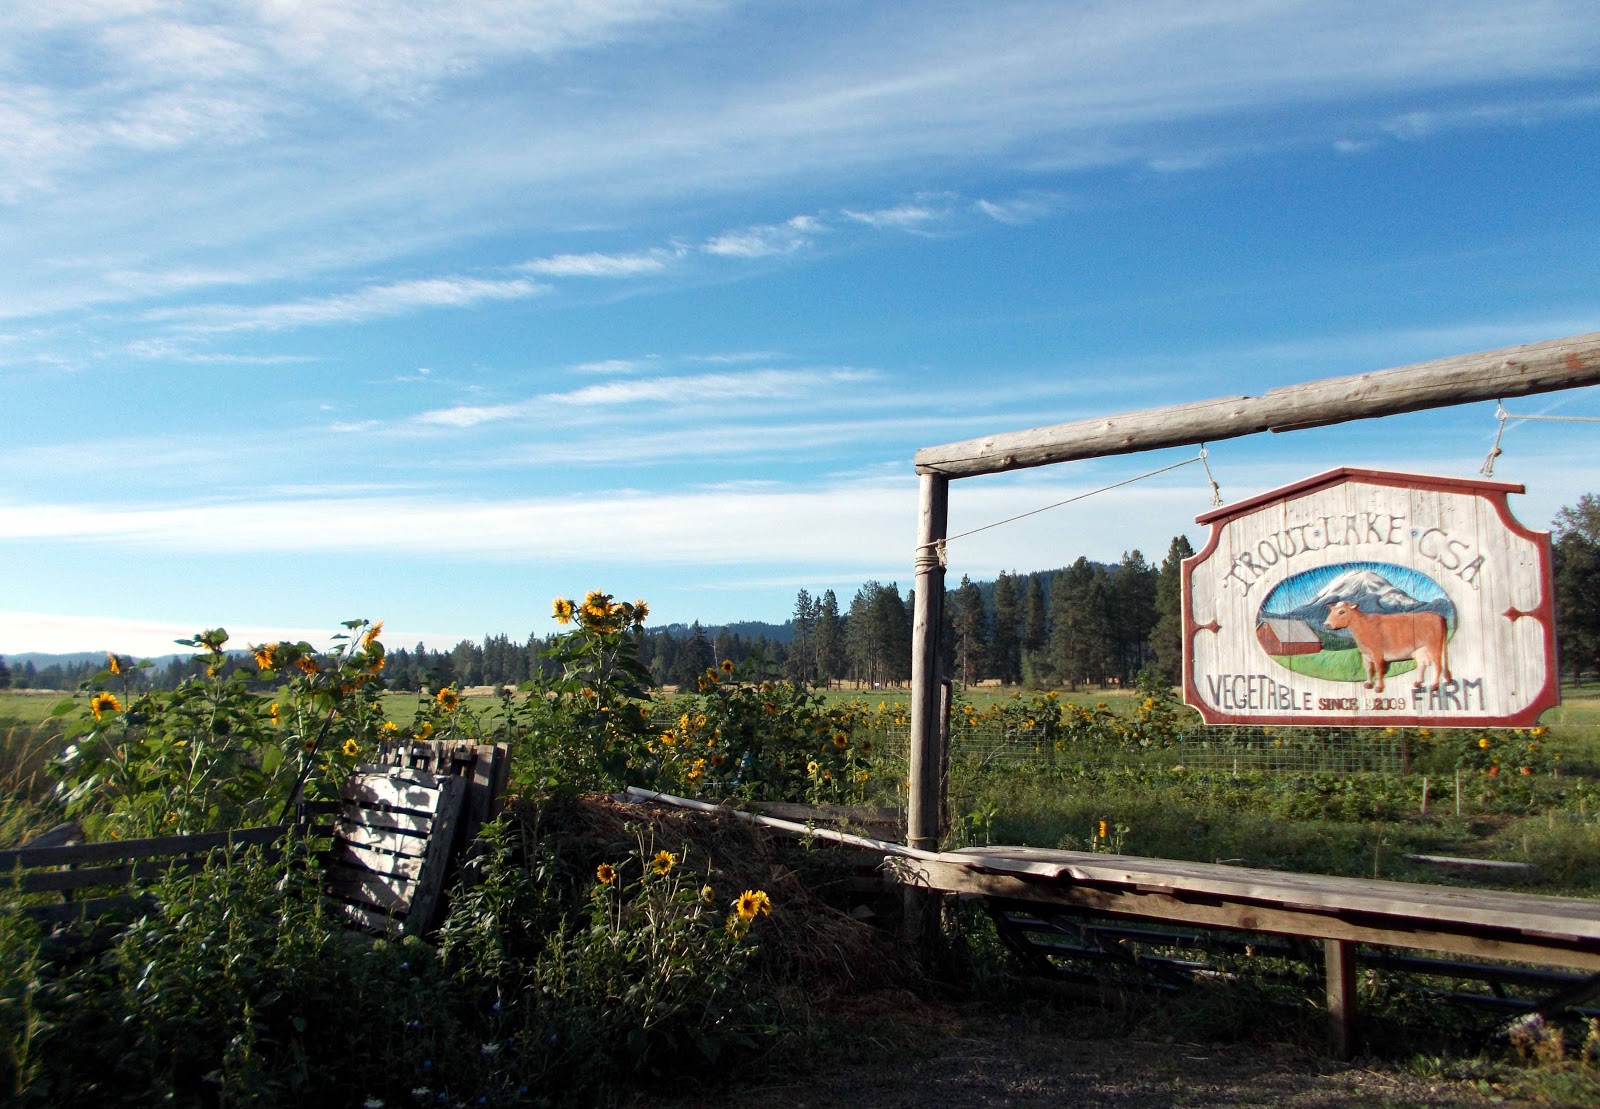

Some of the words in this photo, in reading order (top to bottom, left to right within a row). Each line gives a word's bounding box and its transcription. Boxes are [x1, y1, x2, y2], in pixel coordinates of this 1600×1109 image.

[1223, 522, 1318, 597] TROUT
[1318, 512, 1406, 546] LAKE
[1417, 528, 1487, 590] CSA
[1207, 674, 1313, 710] VEGETABLE
[1318, 698, 1358, 710] SINCE
[1412, 678, 1485, 711] FARM
